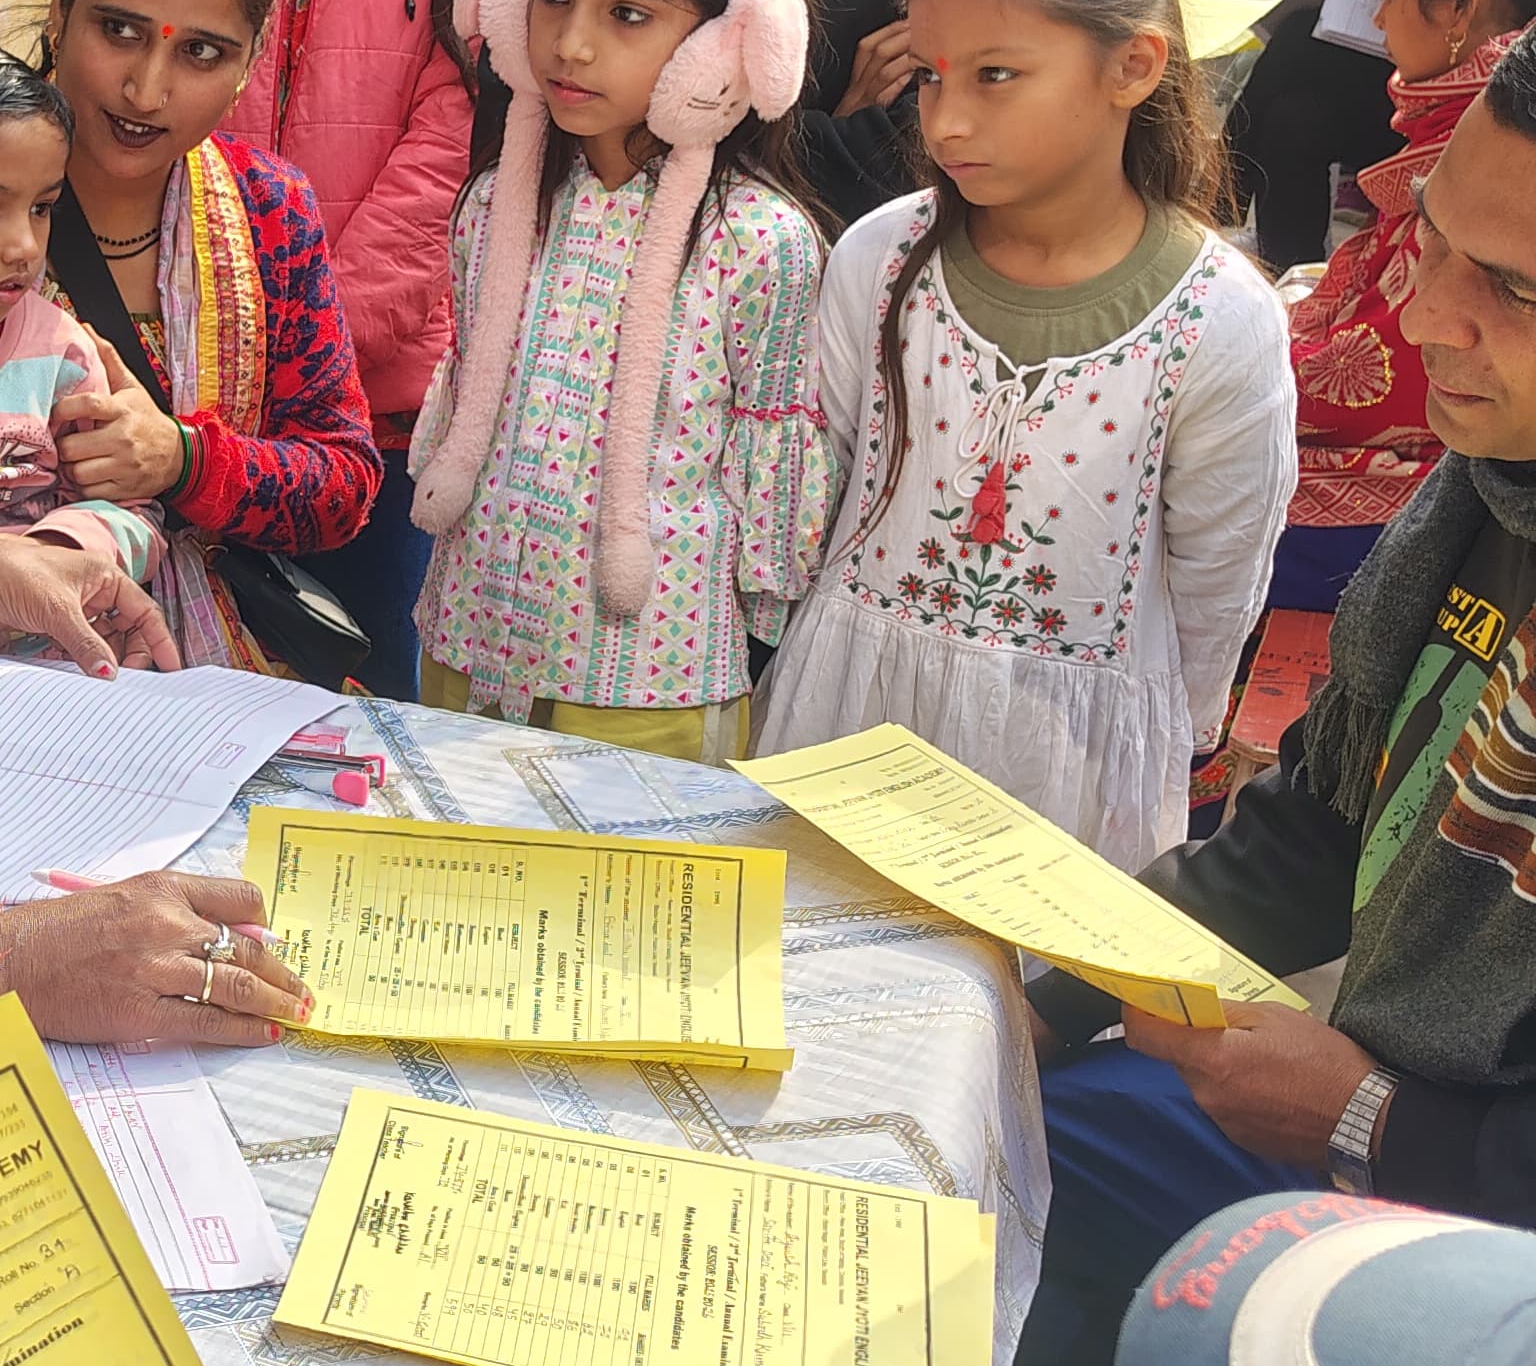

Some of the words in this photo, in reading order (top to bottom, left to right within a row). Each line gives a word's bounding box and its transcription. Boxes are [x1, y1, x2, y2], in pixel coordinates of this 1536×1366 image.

[357, 905, 371, 936] TOTAL
[678, 862, 693, 948] RESIDENTIAL
[536, 908, 548, 940] Marks
[534, 941, 546, 976] obtained
[469, 1176, 488, 1205] TOTAL
[681, 1205, 697, 1233] Marks
[854, 1195, 869, 1262] RESIDENTIAL
[17, 1255, 40, 1277] No.
[678, 1232, 694, 1270] obtained
[675, 1269, 690, 1283] by
[675, 1282, 689, 1299] the
[11, 1279, 57, 1317] Section
[668, 1298, 687, 1351] candidates
